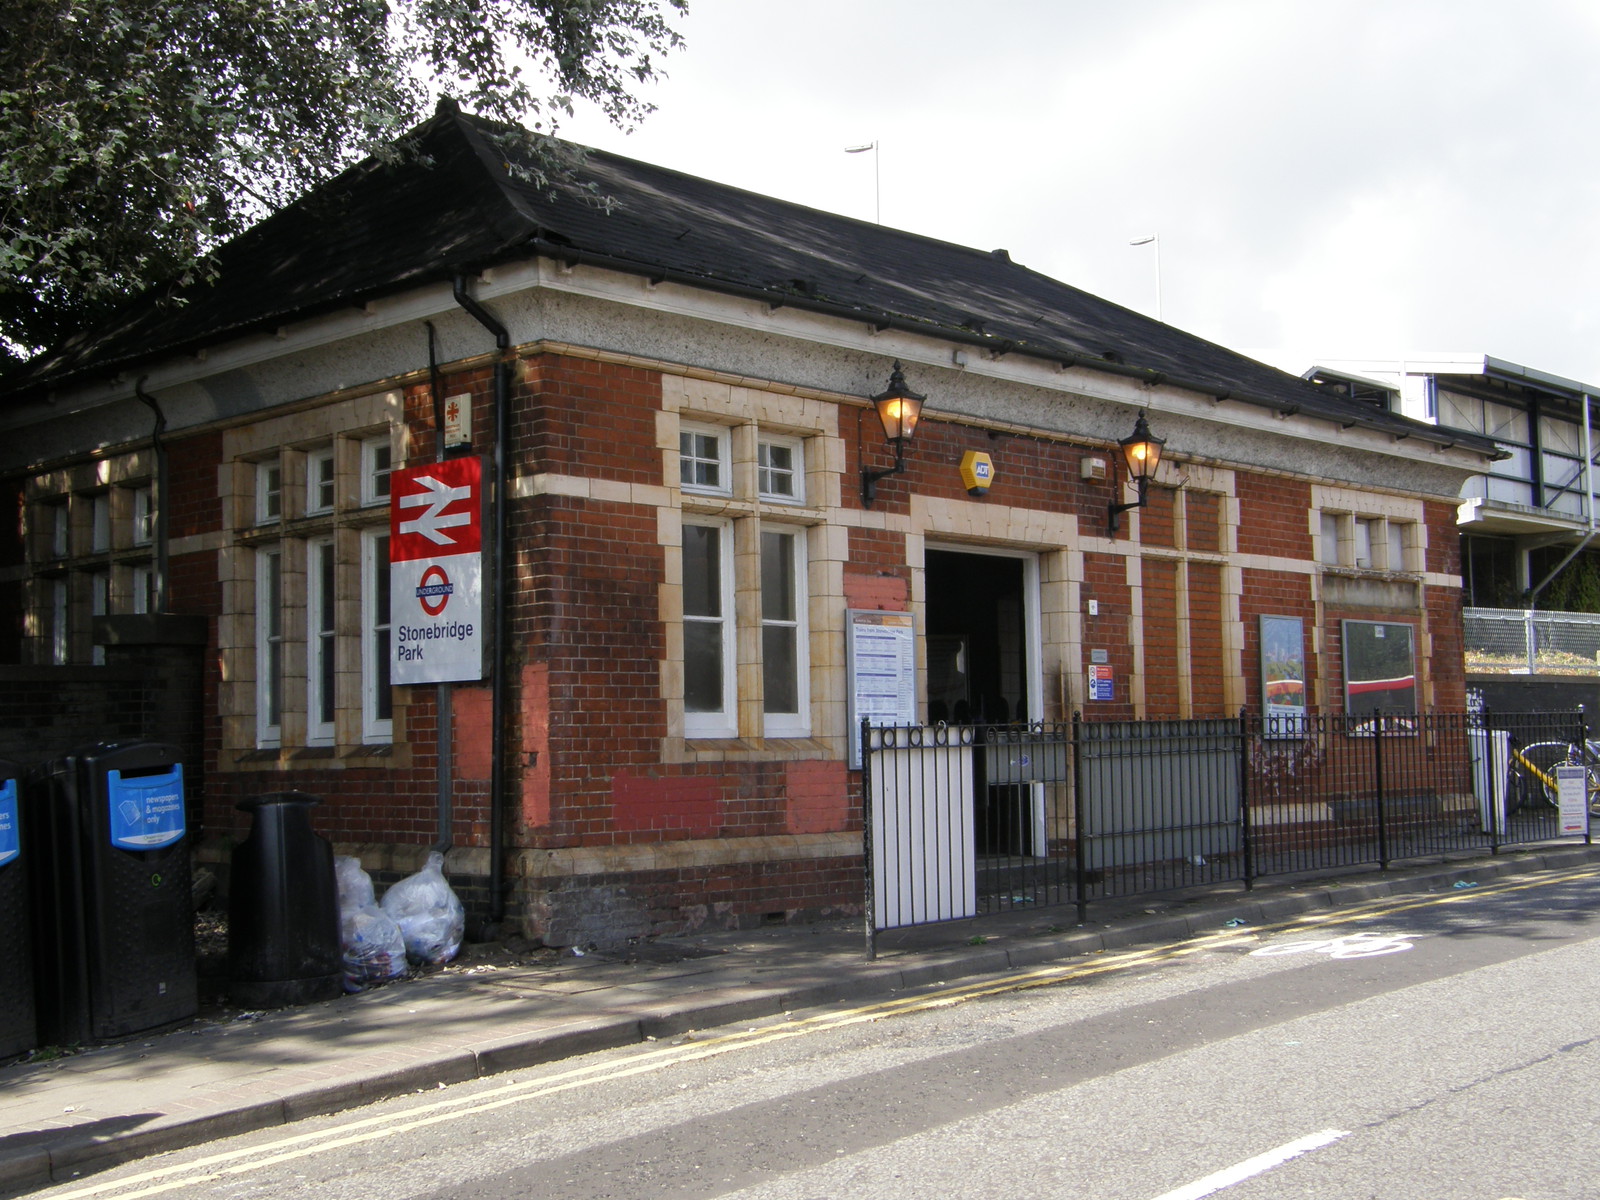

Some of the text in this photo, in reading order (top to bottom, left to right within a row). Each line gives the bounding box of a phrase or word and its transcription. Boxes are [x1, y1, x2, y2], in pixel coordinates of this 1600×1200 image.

[976, 465, 989, 476] ADT
[416, 585, 453, 596] UNDERGROUND
[398, 621, 474, 643] Stonebridge
[398, 645, 424, 661] Park
[146, 794, 179, 804] newspapers
[146, 804, 180, 814] & magazines
[146, 815, 160, 825] only
